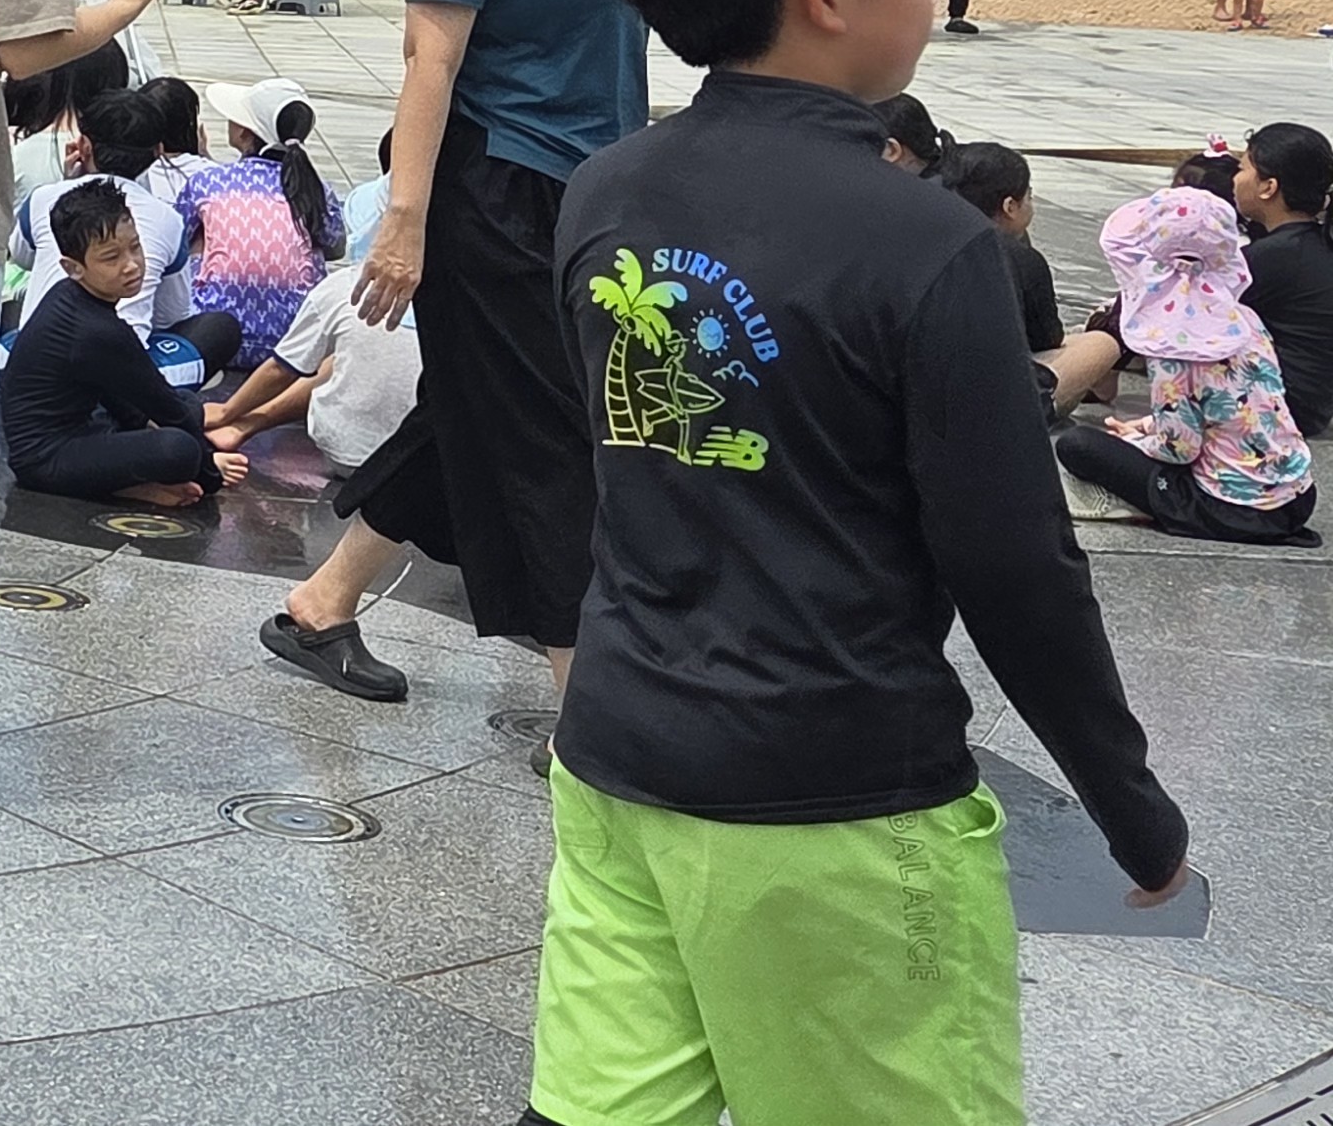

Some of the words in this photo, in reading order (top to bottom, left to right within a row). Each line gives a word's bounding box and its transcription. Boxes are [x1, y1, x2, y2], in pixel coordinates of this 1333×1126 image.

[651, 248, 728, 284] SURF
[722, 278, 780, 362] CLUB
[888, 810, 942, 982] BALANCE
